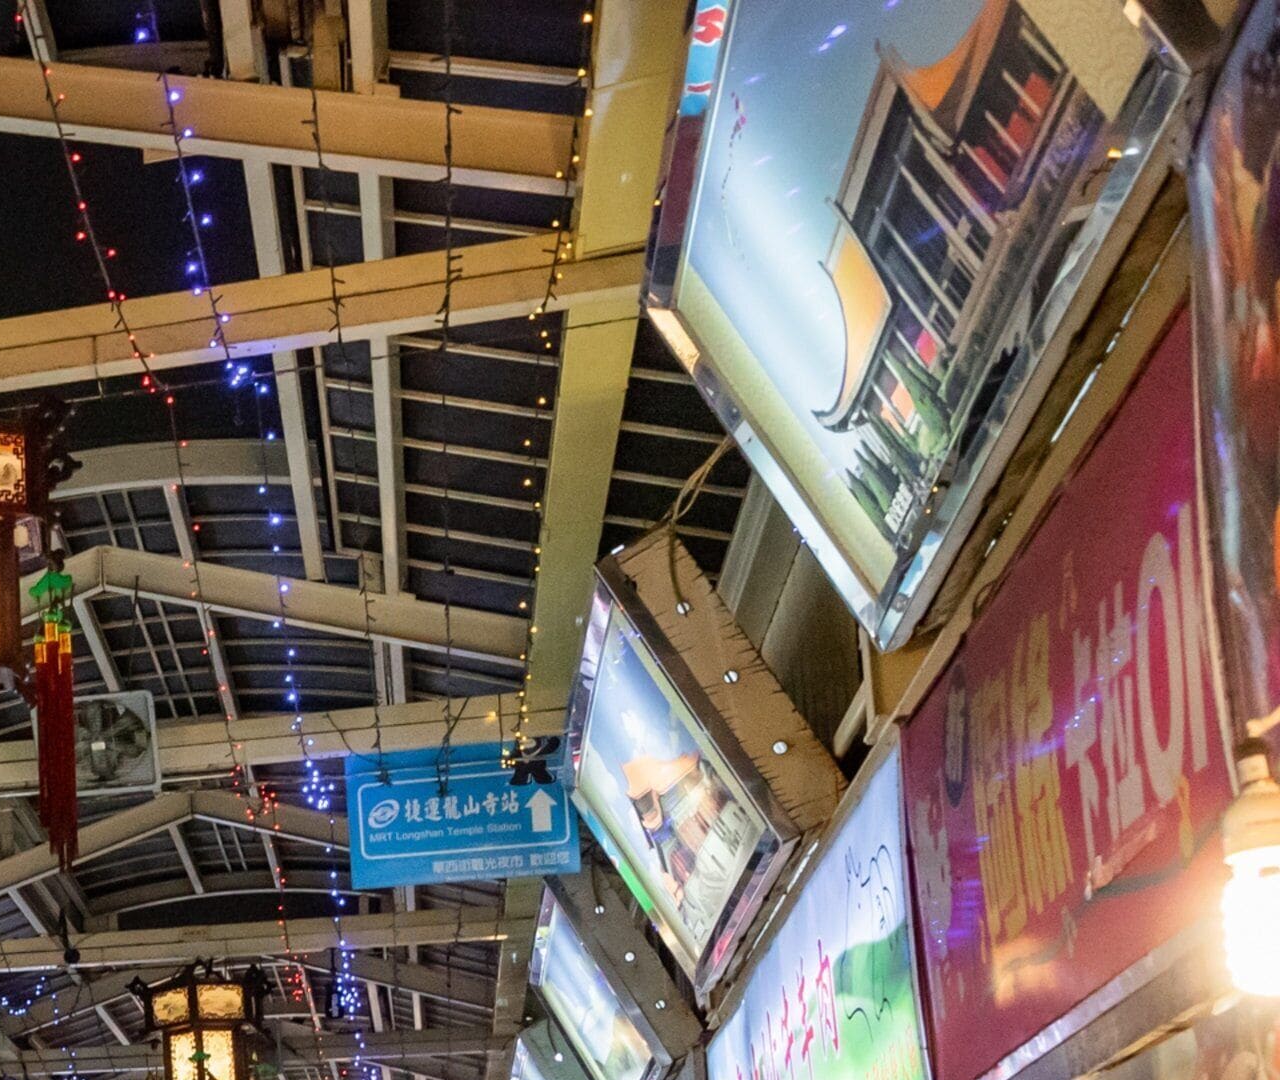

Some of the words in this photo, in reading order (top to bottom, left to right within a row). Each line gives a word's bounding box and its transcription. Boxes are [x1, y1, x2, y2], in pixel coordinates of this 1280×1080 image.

[404, 791, 520, 823] 捷運龍山寺站
[369, 831, 393, 843] MRT
[395, 828, 444, 842] Longshan
[447, 825, 484, 837] Temple
[487, 821, 522, 834] Station
